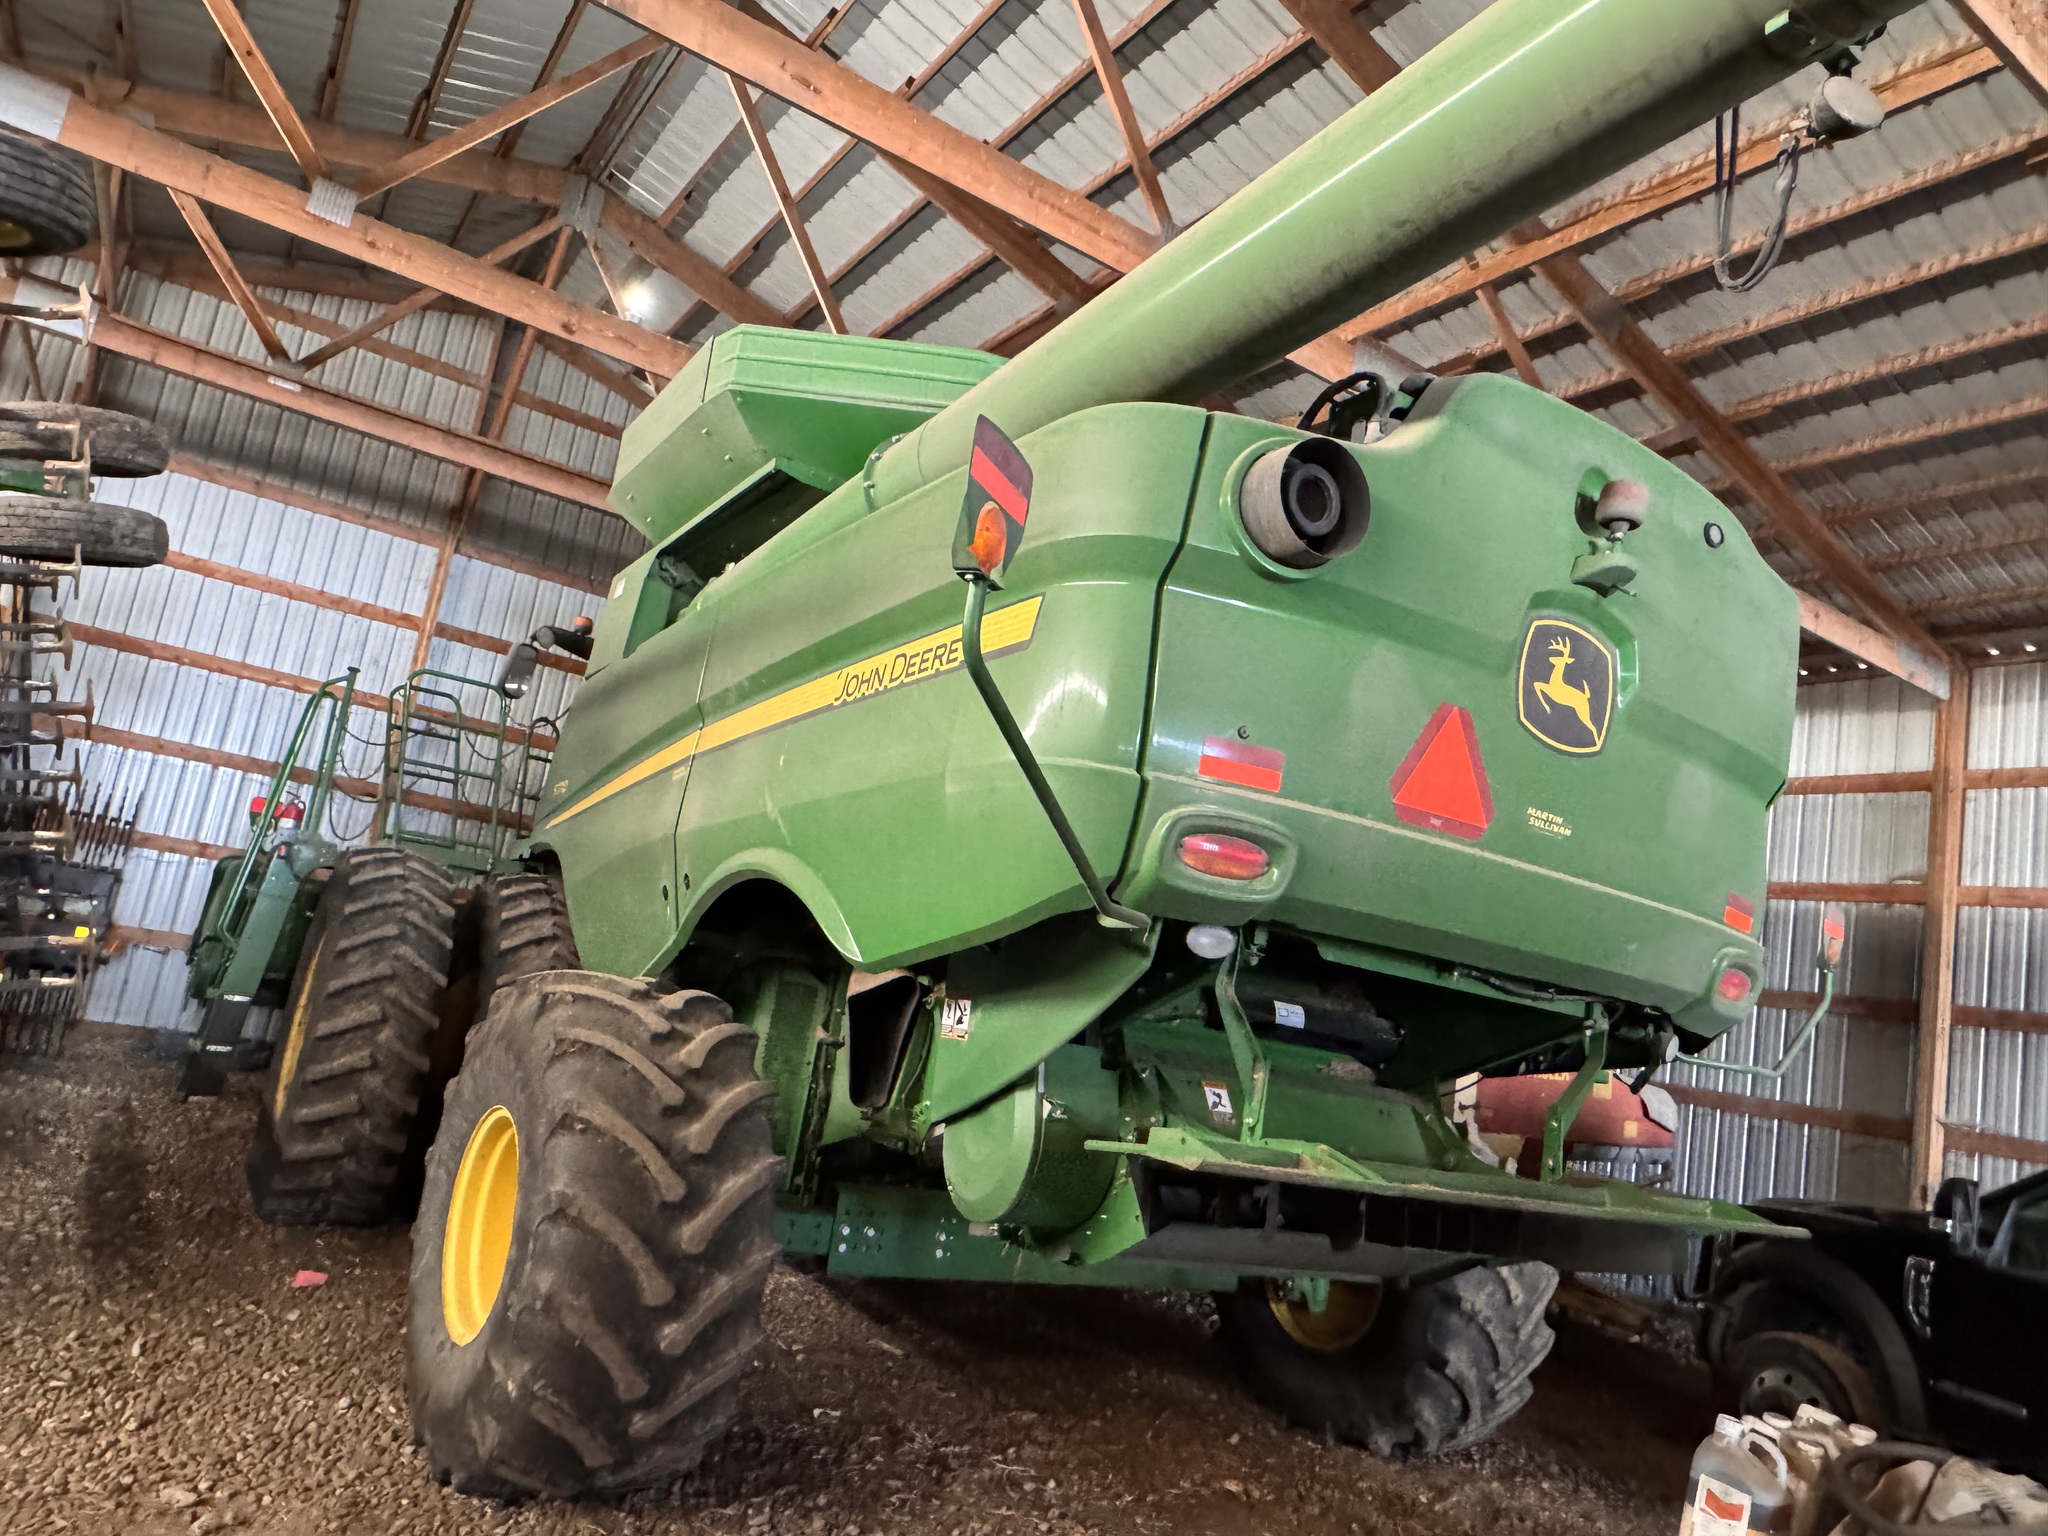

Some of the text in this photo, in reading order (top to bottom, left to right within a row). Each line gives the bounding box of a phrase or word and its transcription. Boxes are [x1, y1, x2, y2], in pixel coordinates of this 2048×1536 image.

[834, 637, 963, 702] JOHN DEERE
[1527, 806, 1563, 824] MARTIN
[1528, 816, 1572, 836] SULLIVAN
